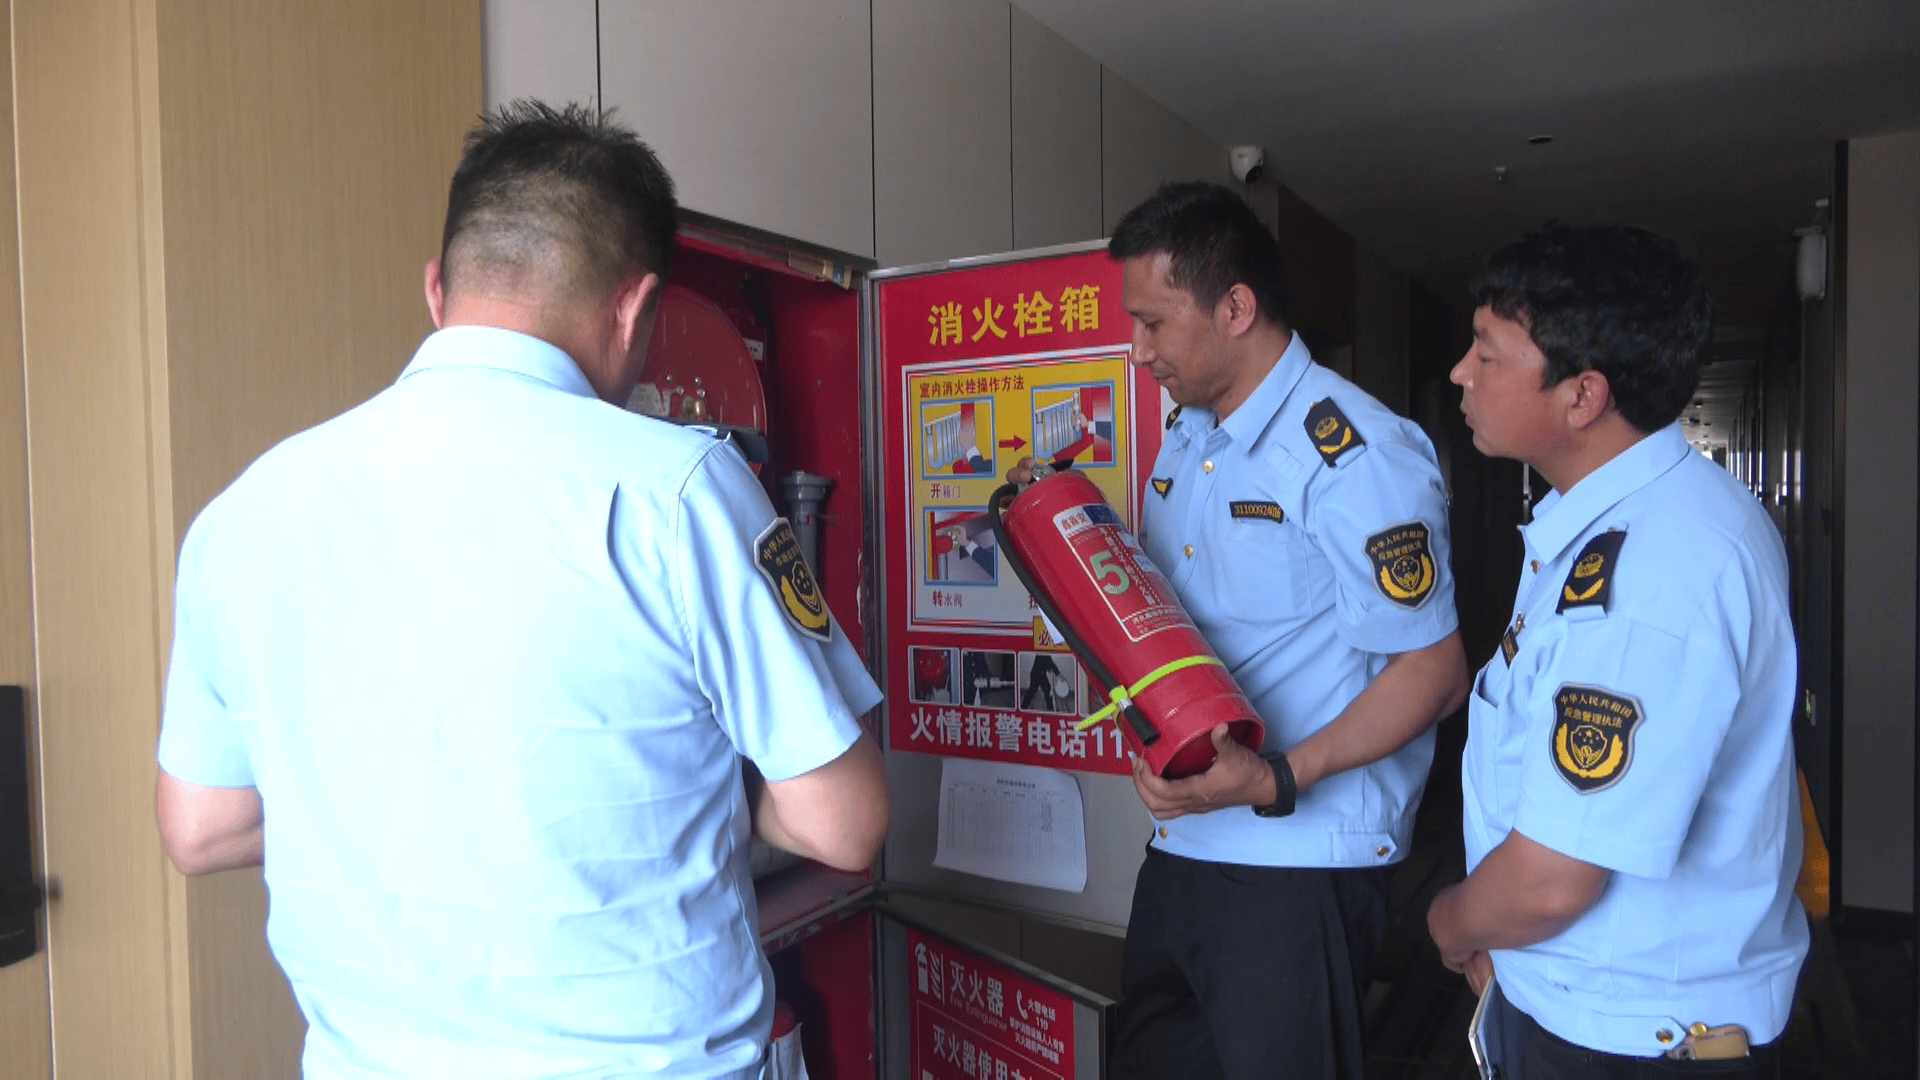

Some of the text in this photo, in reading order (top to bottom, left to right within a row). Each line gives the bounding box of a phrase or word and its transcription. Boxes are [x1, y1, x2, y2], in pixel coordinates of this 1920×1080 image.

[927, 284, 1101, 346] 消火栓箱
[919, 374, 1025, 398] 室内消火栓操作方法
[931, 482, 961, 499] 开箱门
[1370, 530, 1424, 554] 中华人民共和国
[1089, 550, 1130, 595] 5
[932, 590, 962, 607] 转水阀
[1560, 693, 1632, 718] 中华人民共和国
[1564, 706, 1622, 728] 应急管理执法
[910, 706, 1134, 760] 火情报警电话11
[949, 960, 1004, 1018] 灭火器
[965, 1002, 1008, 1033] Extinguisher
